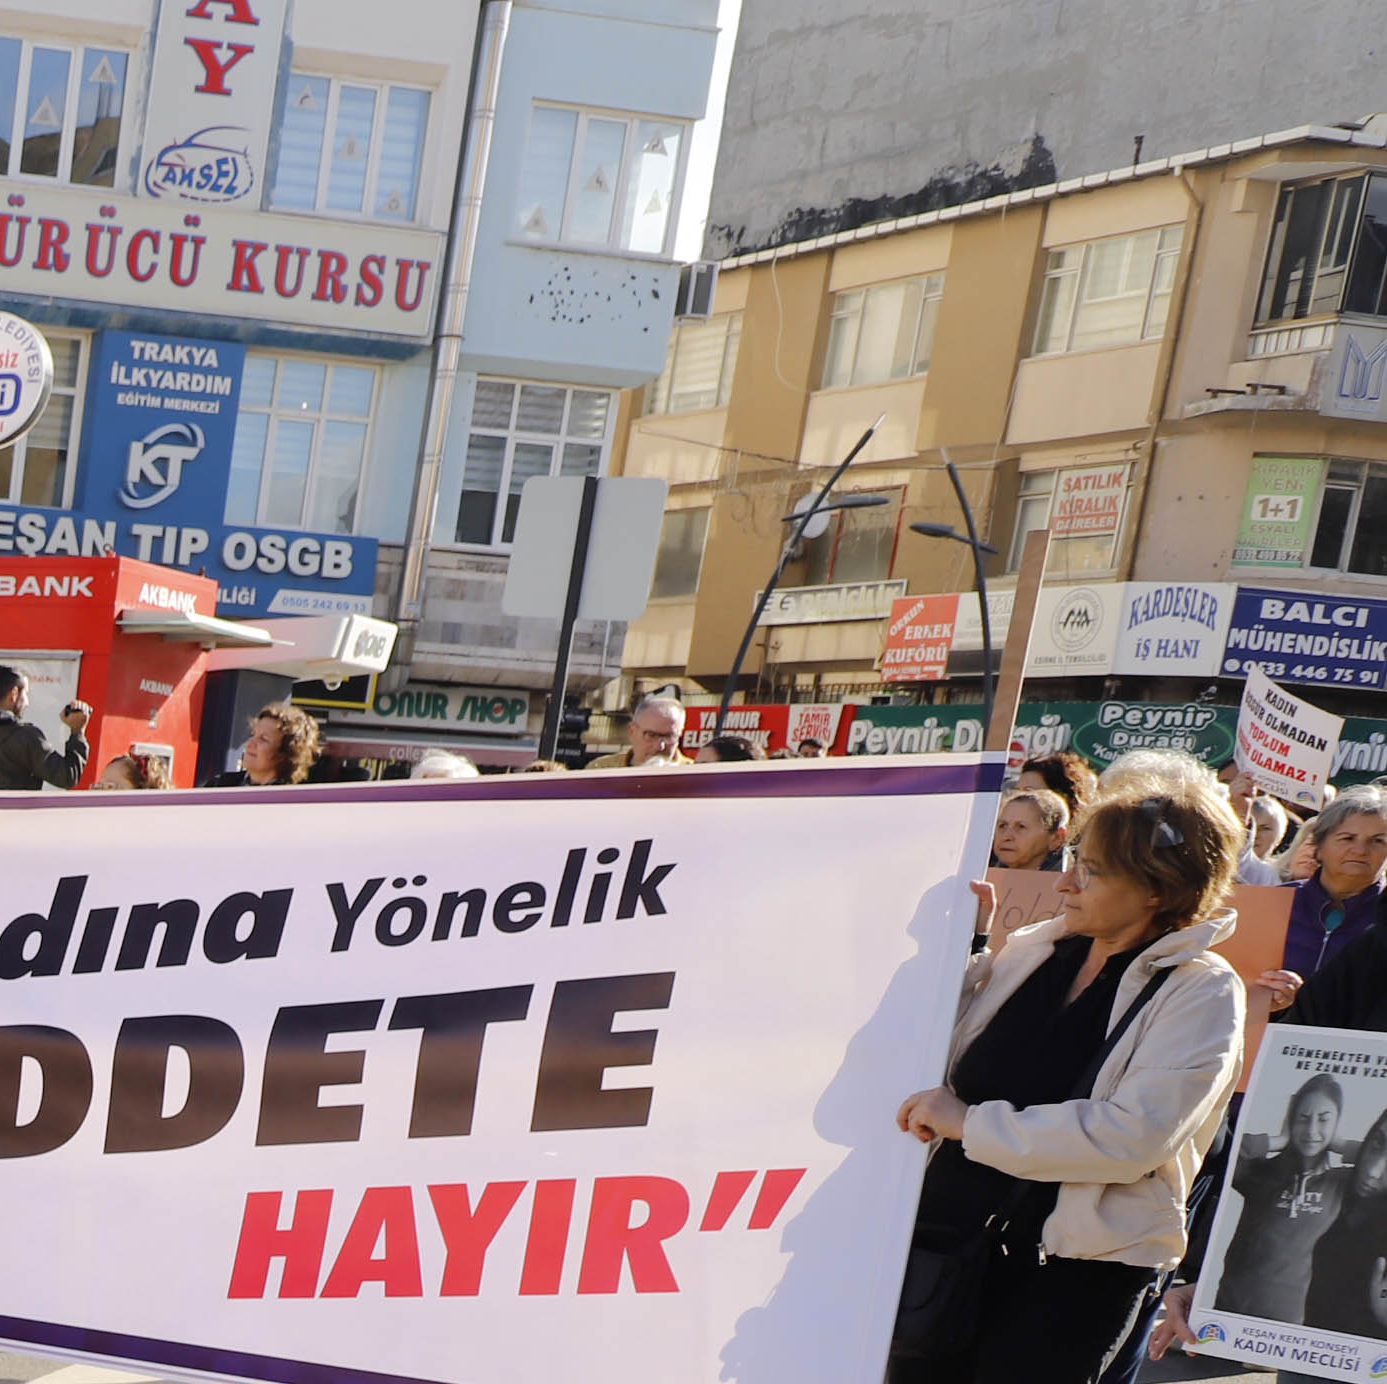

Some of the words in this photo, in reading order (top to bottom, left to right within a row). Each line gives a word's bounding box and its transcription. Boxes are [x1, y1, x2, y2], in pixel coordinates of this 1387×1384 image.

[227, 239, 431, 312] KURSU
[130, 341, 219, 368] TRAKYA
[110, 361, 232, 396] İLKYARDIM
[117, 391, 162, 408] EĞİTİM
[164, 396, 219, 415] MERKEZİ
[1063, 471, 1124, 493] SATILIK
[1059, 493, 1119, 514] KİRALIK
[1258, 498, 1299, 520] 1+1
[131, 523, 209, 566] TIP
[223, 533, 354, 579] OSGB
[139, 583, 197, 613] AKBANK
[282, 596, 310, 608] 0505
[312, 599, 334, 610] 242
[1127, 586, 1218, 631] KARDEŞLER
[1260, 599, 1369, 628] BALCI
[1135, 638, 1151, 659] İŞ
[1156, 638, 1201, 660] HANI
[1227, 625, 1387, 662] MÜHENDİSLİK
[140, 679, 173, 695] AKBANK
[1291, 663, 1327, 681] 446
[1334, 667, 1355, 683] 75
[1360, 670, 1380, 686] 91
[1103, 704, 1212, 729] Peynir
[1265, 688, 1298, 718] KADIN
[700, 711, 760, 729] YAMUR
[1265, 713, 1328, 752] OLMADAN
[848, 717, 949, 755] Peynir
[1113, 729, 1193, 750] Durağı
[1250, 722, 1291, 757] TOPLUM
[1251, 750, 1307, 782] OLAMAZ
[324, 839, 677, 953] Yönelik
[1234, 1337, 1286, 1358] KADIN
[1291, 1348, 1360, 1372] MECLİSİ
[1242, 1326, 1277, 1341] KEŞAN
[1279, 1332, 1308, 1346] KENT
[1310, 1337, 1359, 1356] KONSEYİ
